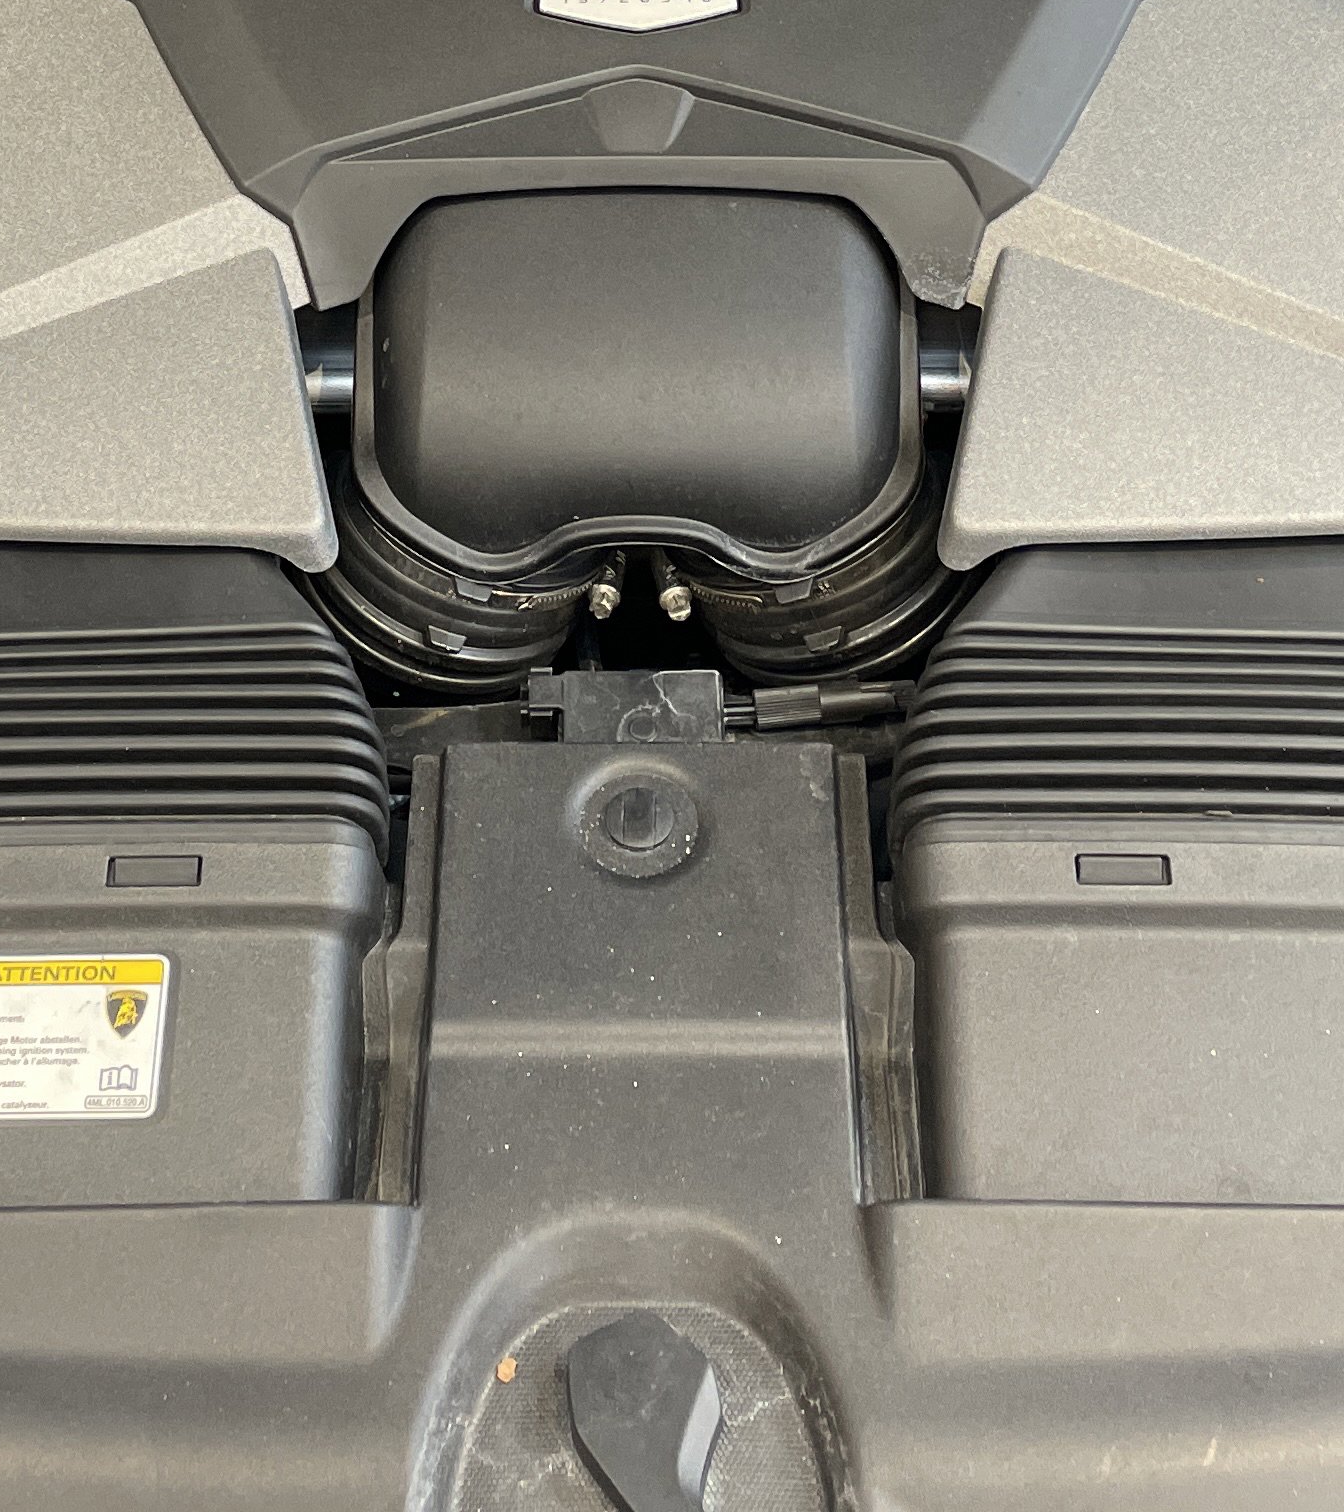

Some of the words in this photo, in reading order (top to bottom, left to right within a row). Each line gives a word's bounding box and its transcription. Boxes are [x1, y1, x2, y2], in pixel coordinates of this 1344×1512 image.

[10, 1036, 37, 1044] Motor
[18, 1047, 53, 1058] ignition
[87, 1098, 103, 1106] 4ML
[106, 1098, 121, 1106] 010
[123, 1098, 137, 1106] 520
[138, 1098, 145, 1106] A
